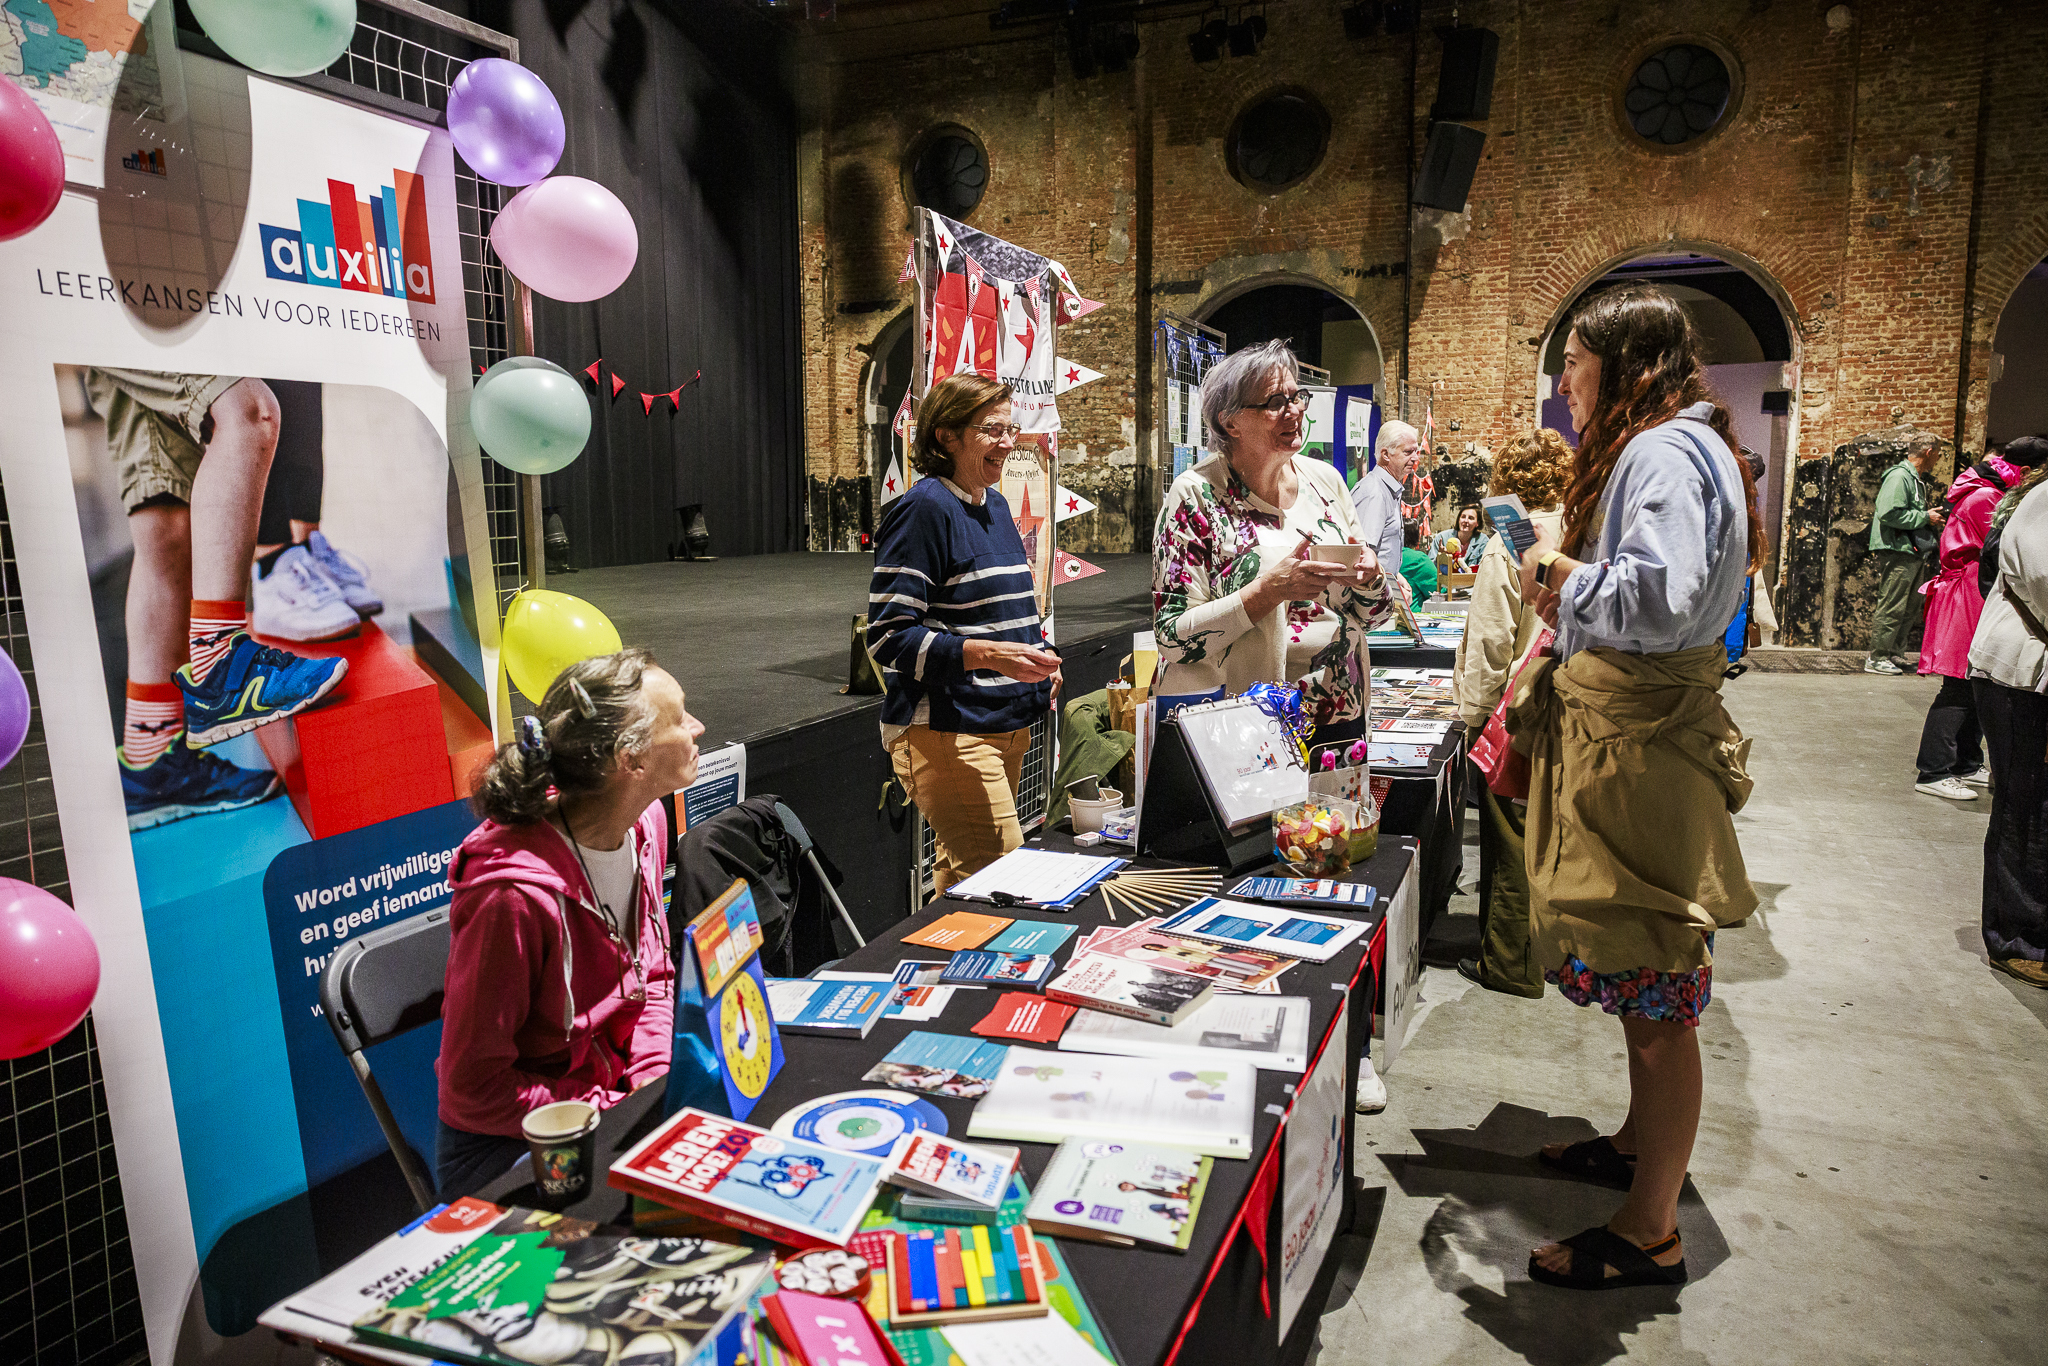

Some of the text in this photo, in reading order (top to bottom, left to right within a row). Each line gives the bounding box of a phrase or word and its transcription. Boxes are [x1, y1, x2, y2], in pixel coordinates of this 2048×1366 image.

[271, 237, 431, 296] auxilia
[37, 268, 441, 342] LEERKANSEN VOOR IEDEREEN
[294, 876, 357, 914] Word
[300, 922, 330, 945] en
[333, 898, 381, 940] geef
[816, 985, 857, 1019] HUISWERK
[842, 985, 873, 1009] HELPEN
[645, 1118, 733, 1182] LEREN
[679, 1149, 734, 1191] HOE?
[359, 1266, 408, 1297] EVEN
